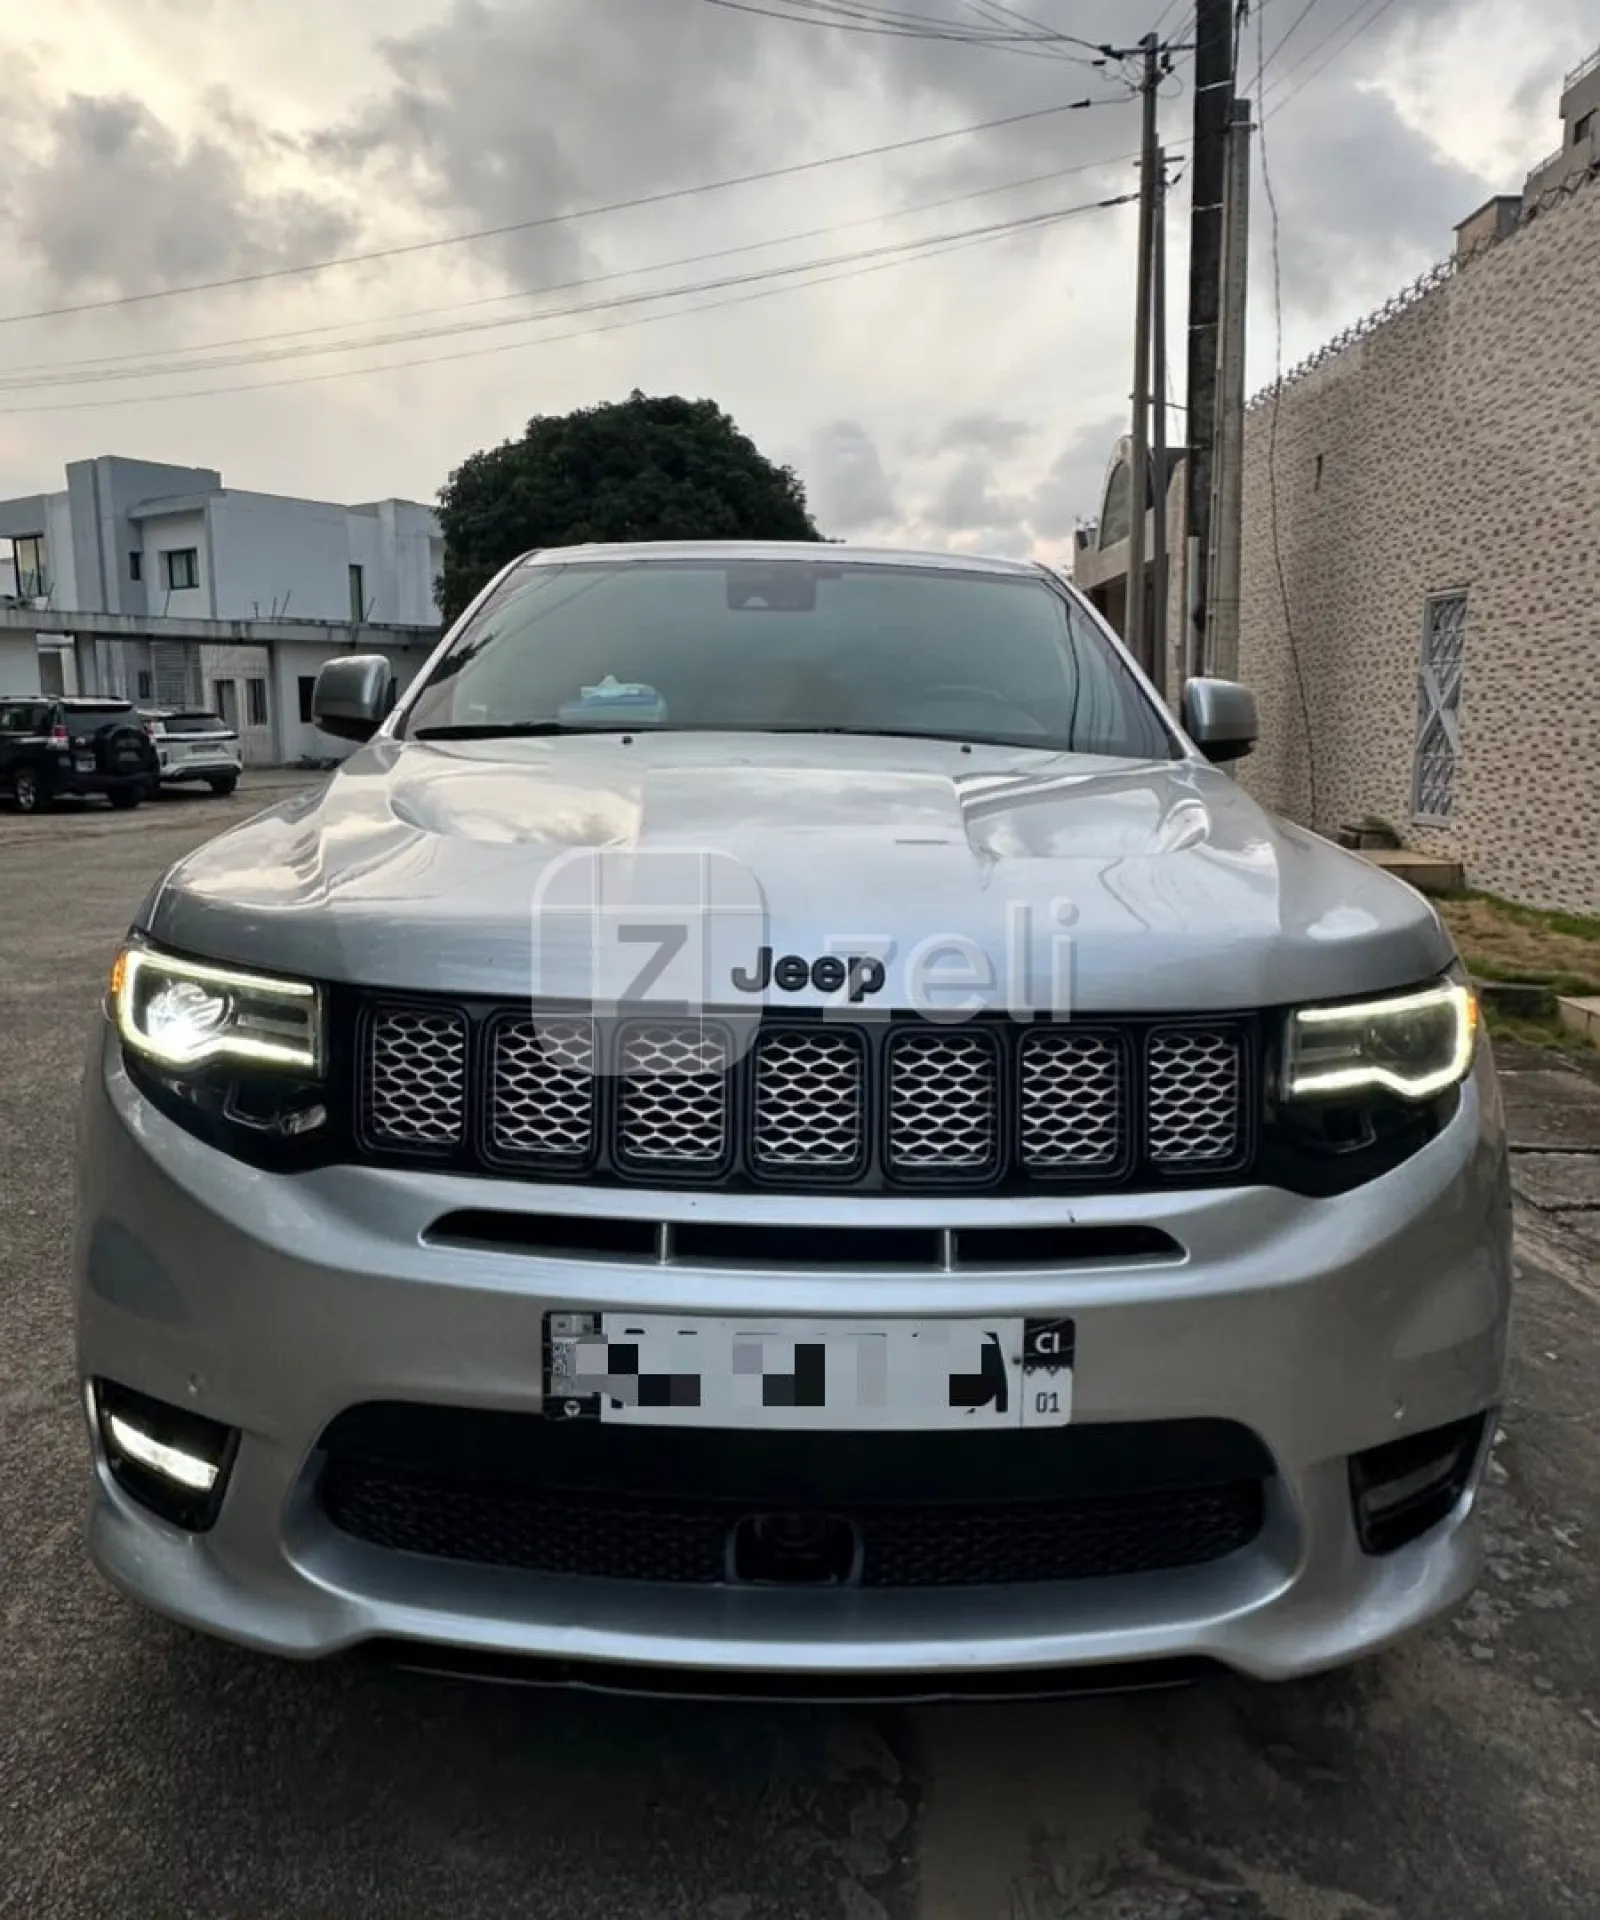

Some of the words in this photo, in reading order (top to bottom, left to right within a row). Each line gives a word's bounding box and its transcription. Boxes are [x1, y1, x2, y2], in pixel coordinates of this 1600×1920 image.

[731, 945, 886, 1003] Jeep
[1035, 1332, 1060, 1354] CI
[1035, 1391, 1060, 1413] 01
